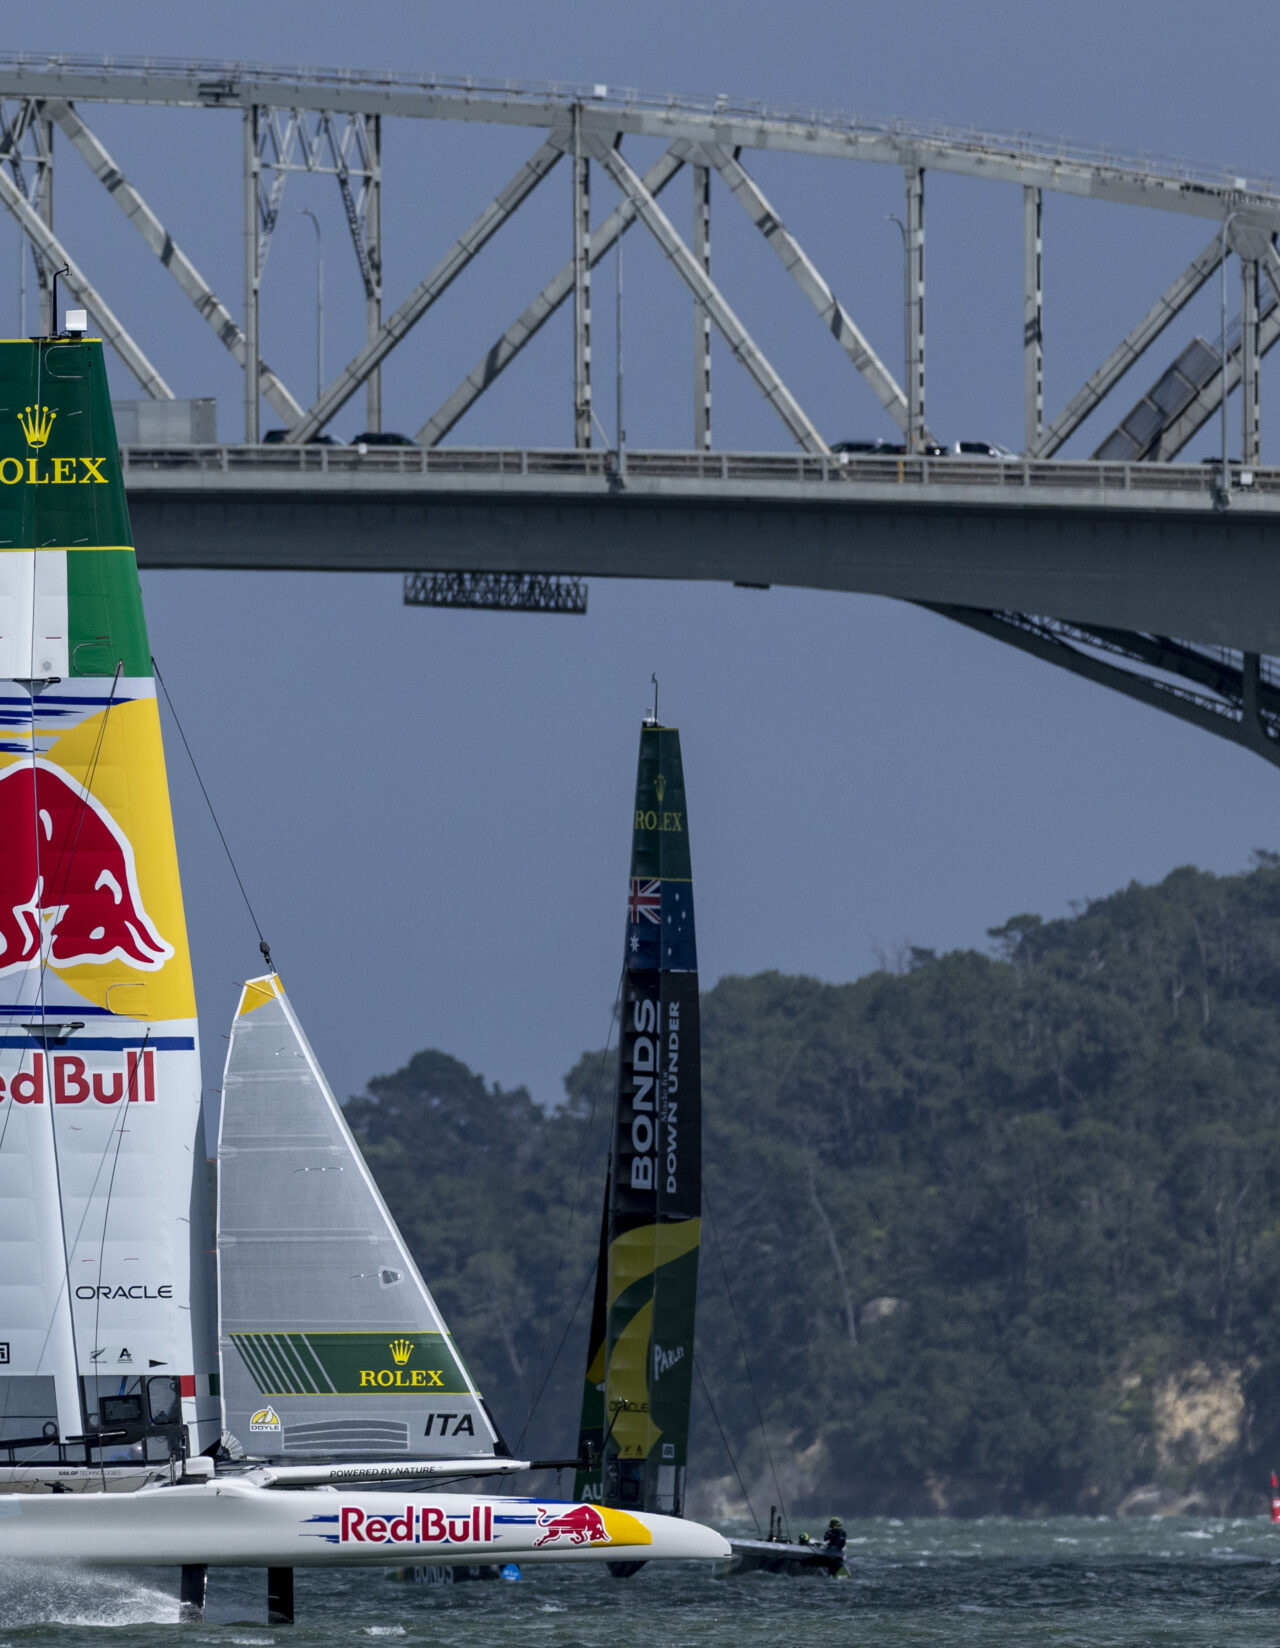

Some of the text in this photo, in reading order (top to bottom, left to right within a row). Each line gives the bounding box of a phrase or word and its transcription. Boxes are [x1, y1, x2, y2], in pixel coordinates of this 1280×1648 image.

[53, 1050, 156, 1105] Bull
[631, 998, 655, 1190] BONDS
[666, 1001, 680, 1193] DOWN UNDER
[75, 1285, 173, 1299] ORACLE
[359, 1369, 445, 1387] ROLEX
[423, 1413, 475, 1437] ITA
[329, 1467, 379, 1478] POWERED
[380, 1466, 394, 1476] BY
[580, 1483, 603, 1501] AU
[340, 1505, 493, 1542] Red Bull
